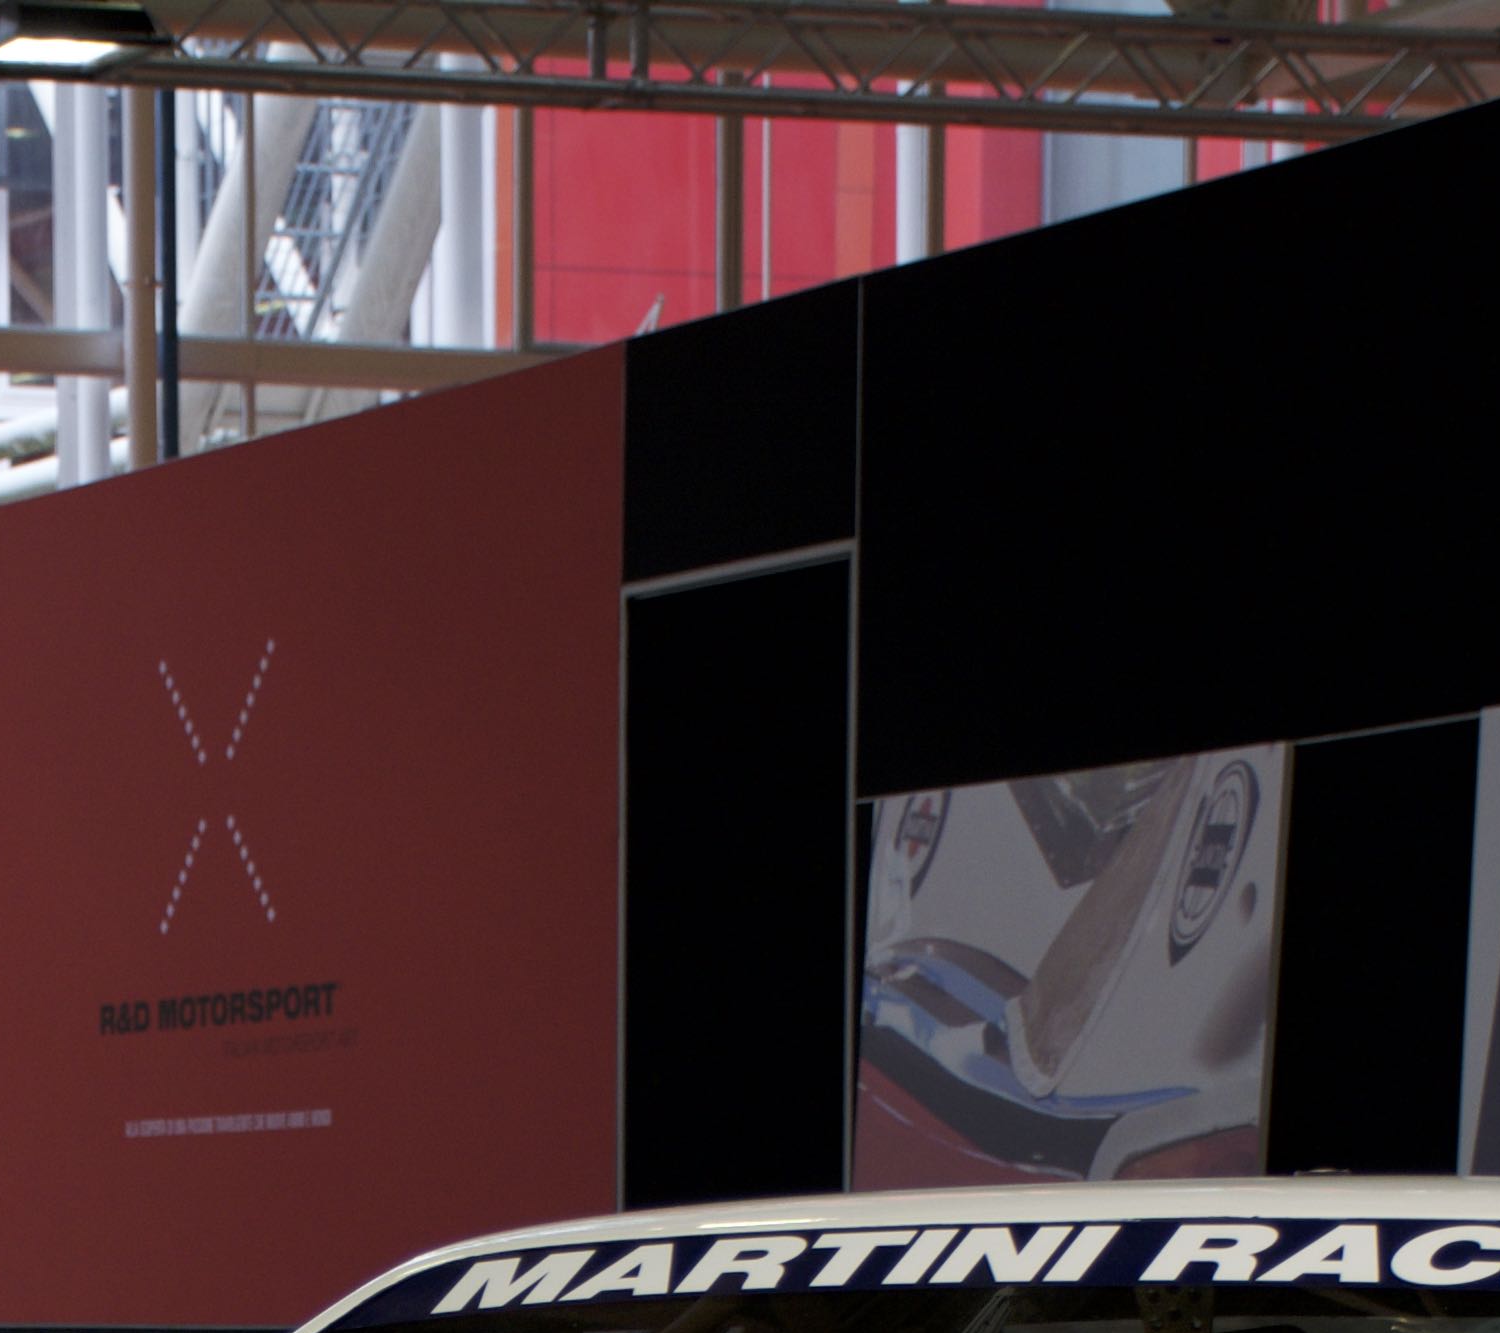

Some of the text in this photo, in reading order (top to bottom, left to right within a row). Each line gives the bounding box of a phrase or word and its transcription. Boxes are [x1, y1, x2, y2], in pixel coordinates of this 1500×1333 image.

[100, 983, 338, 1035] R&D MOTORSPORT
[432, 1225, 1122, 1315] MARTINI
